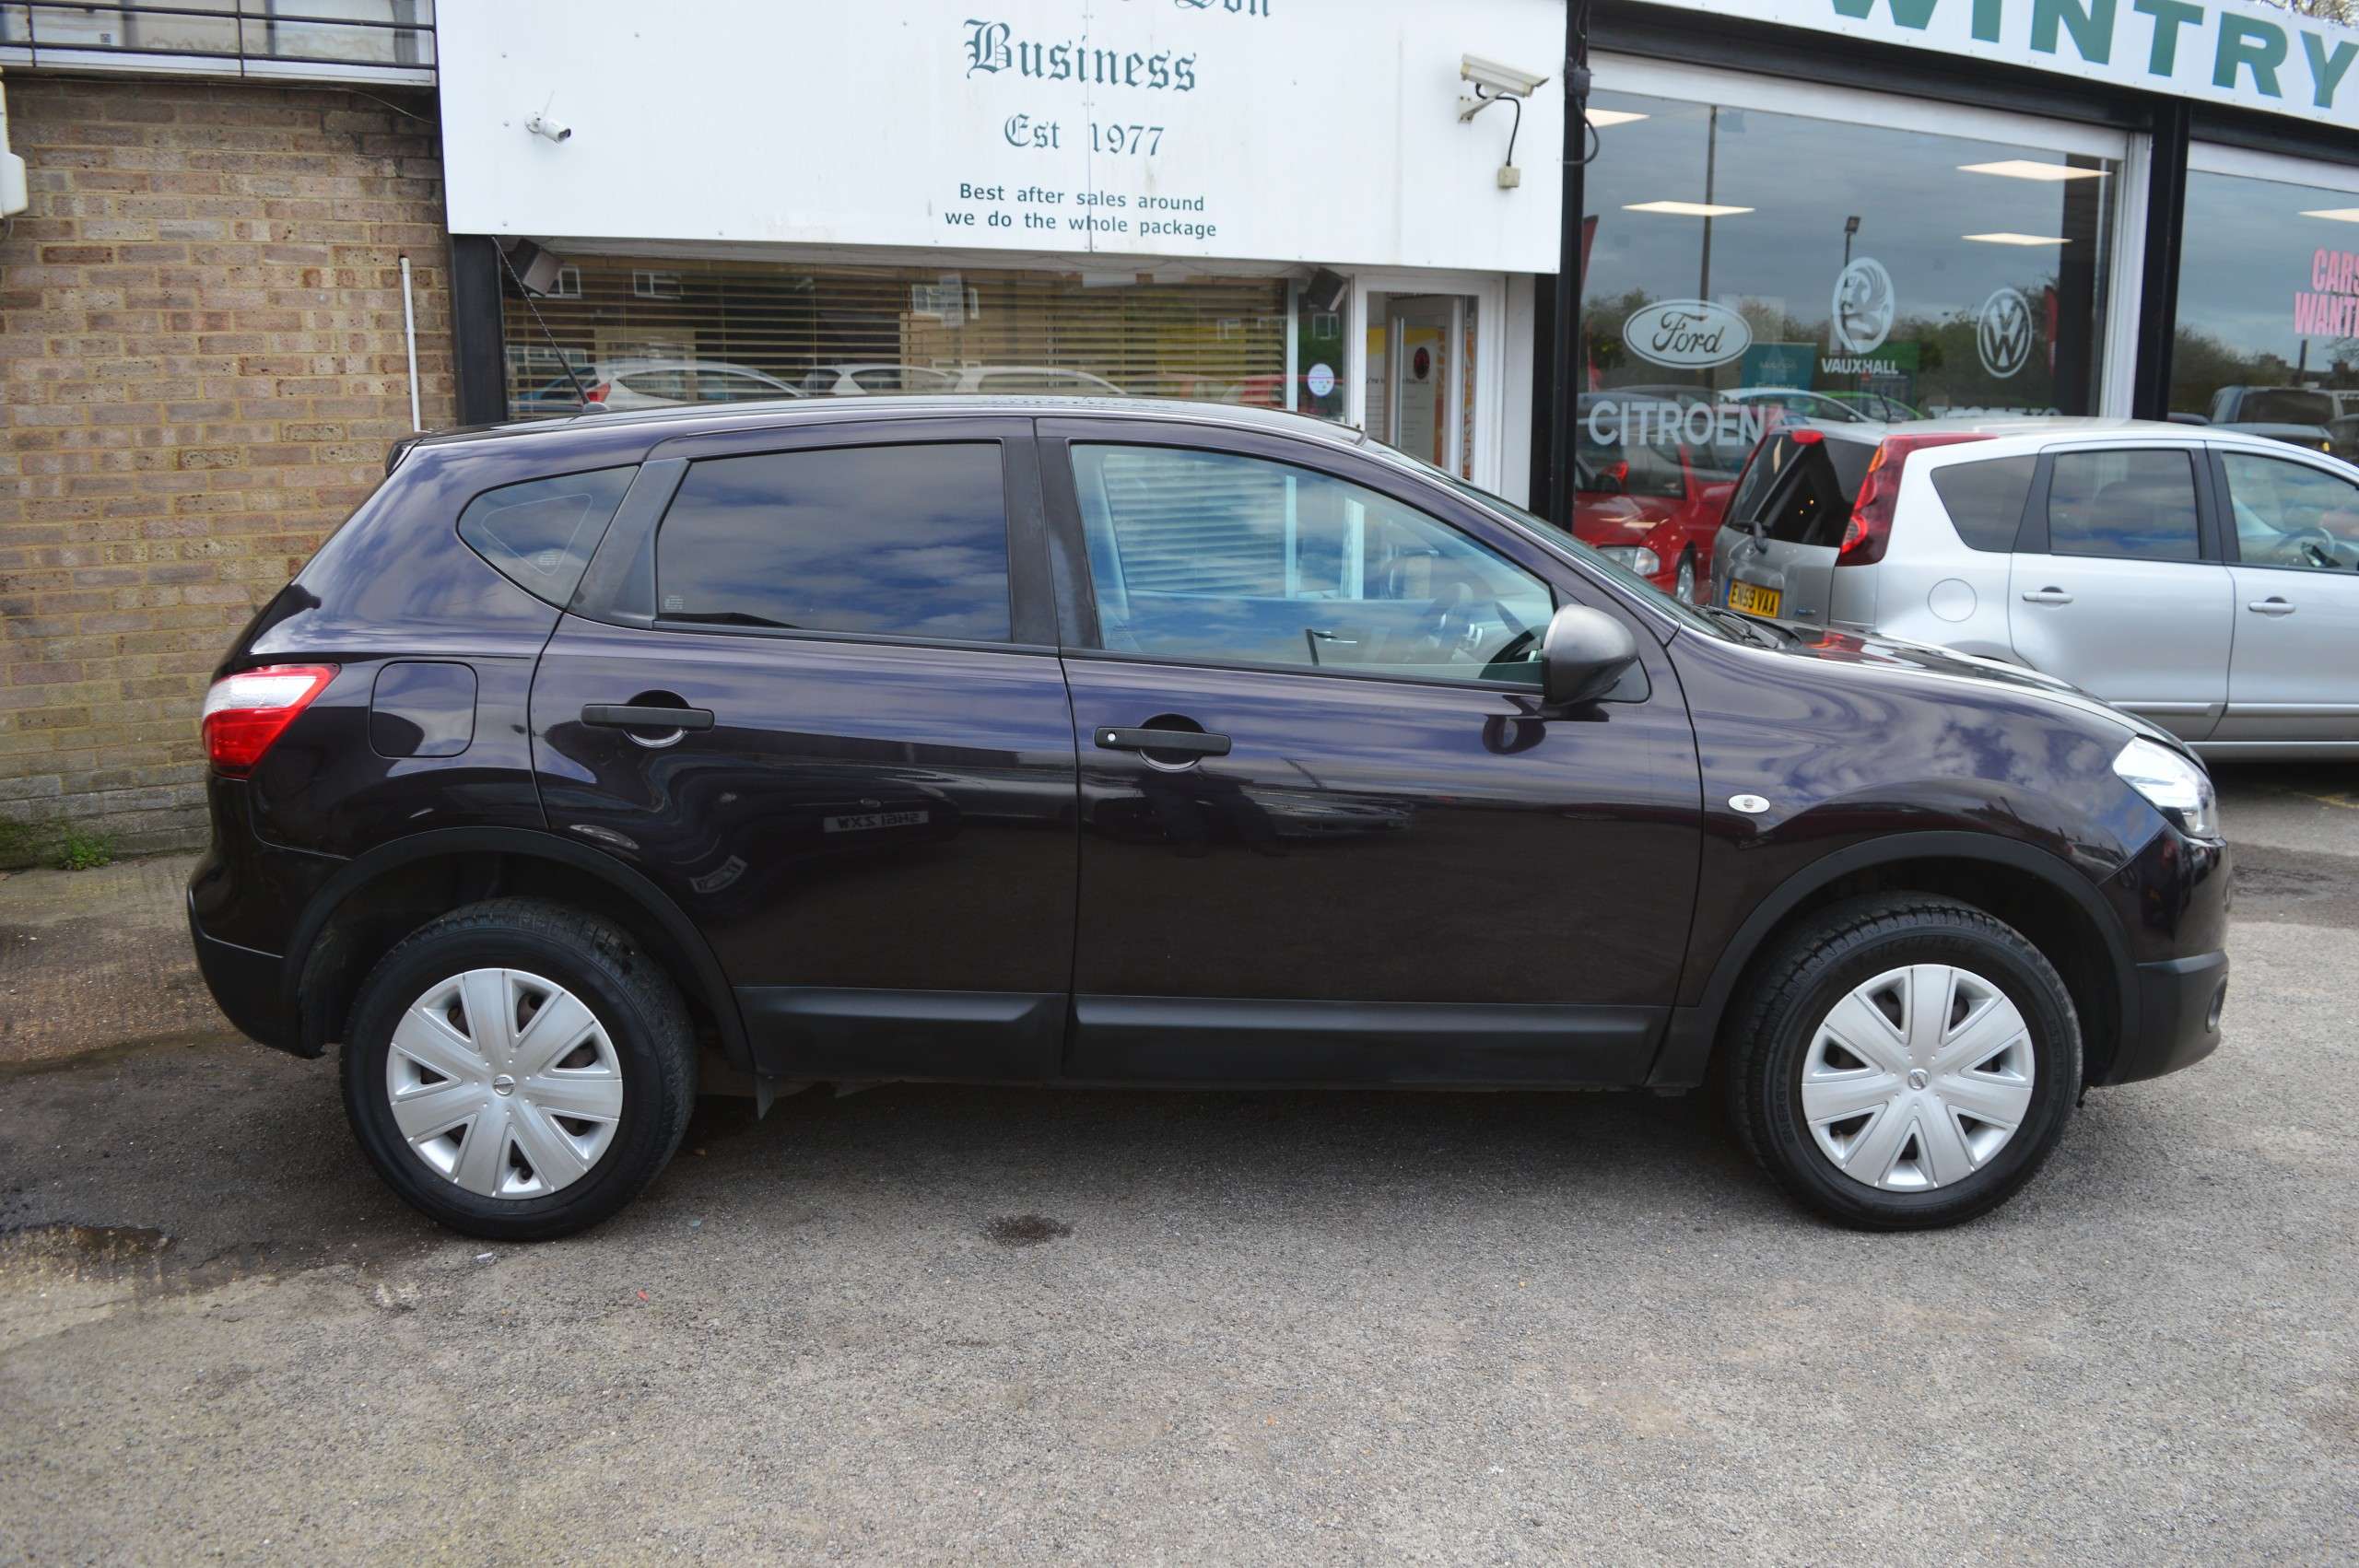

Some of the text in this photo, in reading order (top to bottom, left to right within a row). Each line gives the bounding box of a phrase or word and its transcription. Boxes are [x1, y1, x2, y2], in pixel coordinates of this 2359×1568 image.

[964, 18, 1196, 92] Business
[1004, 113, 1165, 156] Est 1977
[960, 183, 1204, 211] Best after sales around
[945, 211, 1216, 240] we do the whole package
[1652, 311, 1725, 353] Ford
[1821, 357, 1899, 375] VAUXHALL
